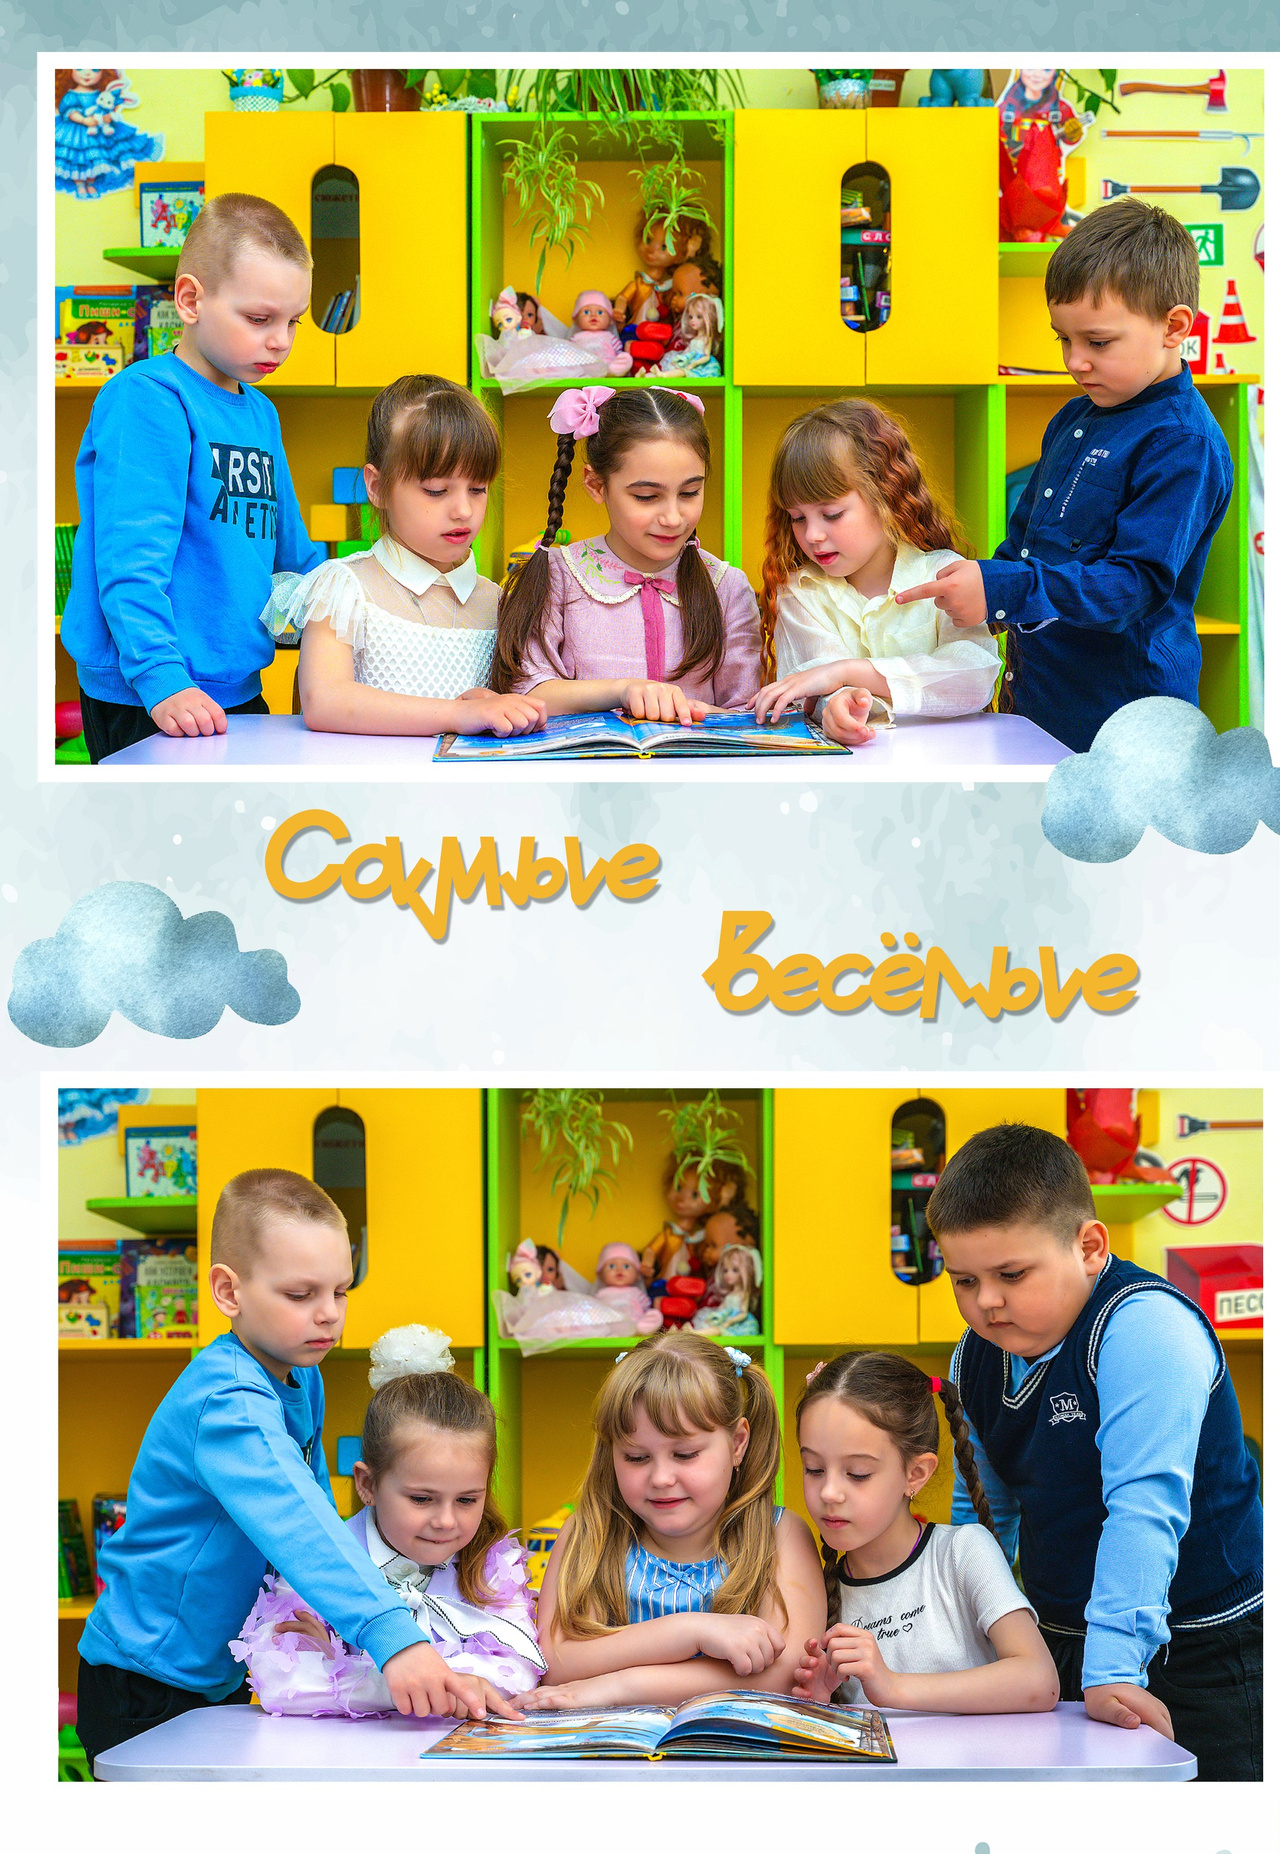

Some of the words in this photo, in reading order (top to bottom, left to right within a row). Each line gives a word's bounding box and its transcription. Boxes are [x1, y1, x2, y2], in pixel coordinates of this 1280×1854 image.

[1059, 1398, 1075, 1411] M
[900, 1604, 926, 1621] come
[876, 1627, 900, 1641] true
